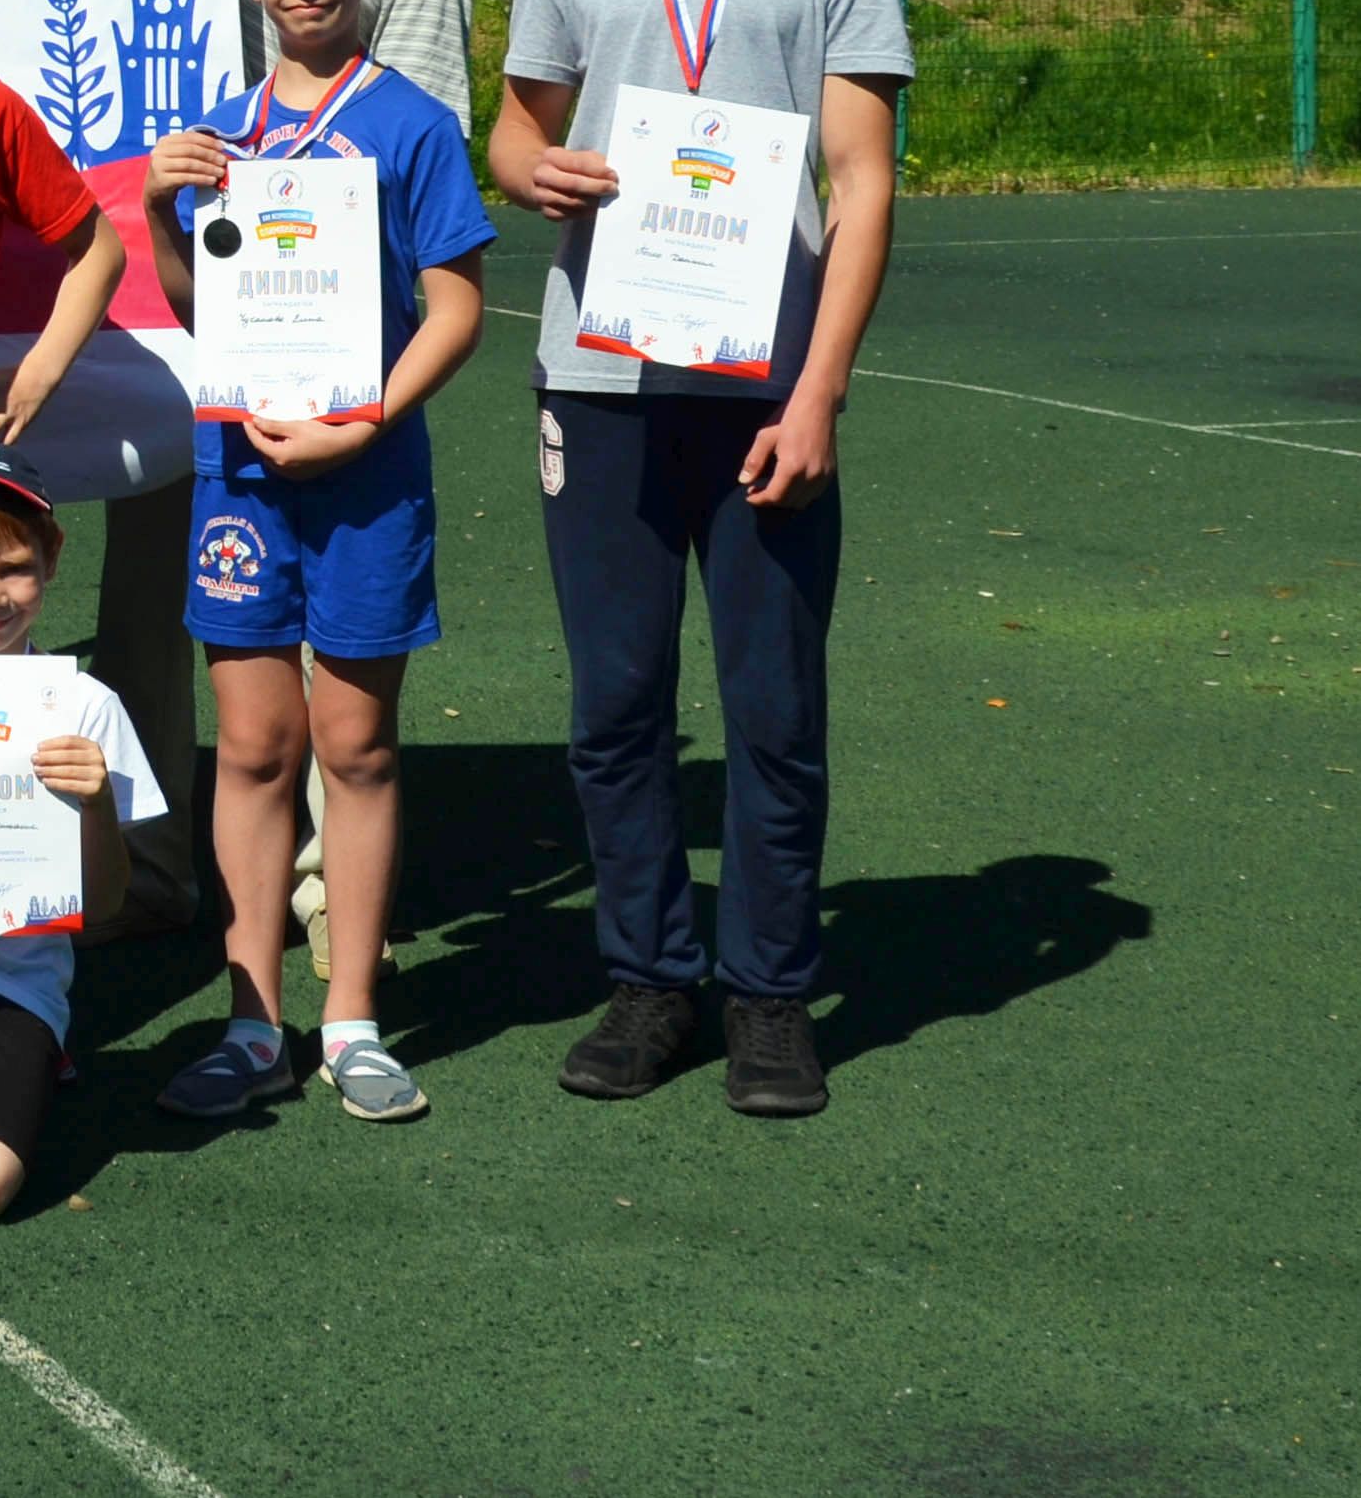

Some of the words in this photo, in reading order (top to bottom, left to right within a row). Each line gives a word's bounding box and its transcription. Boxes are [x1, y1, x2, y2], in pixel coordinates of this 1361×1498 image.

[689, 189, 709, 200] 2019
[640, 202, 749, 244] ДИПЛОМ
[278, 250, 296, 259] 2019
[237, 269, 339, 299] ДИПЛОМ
